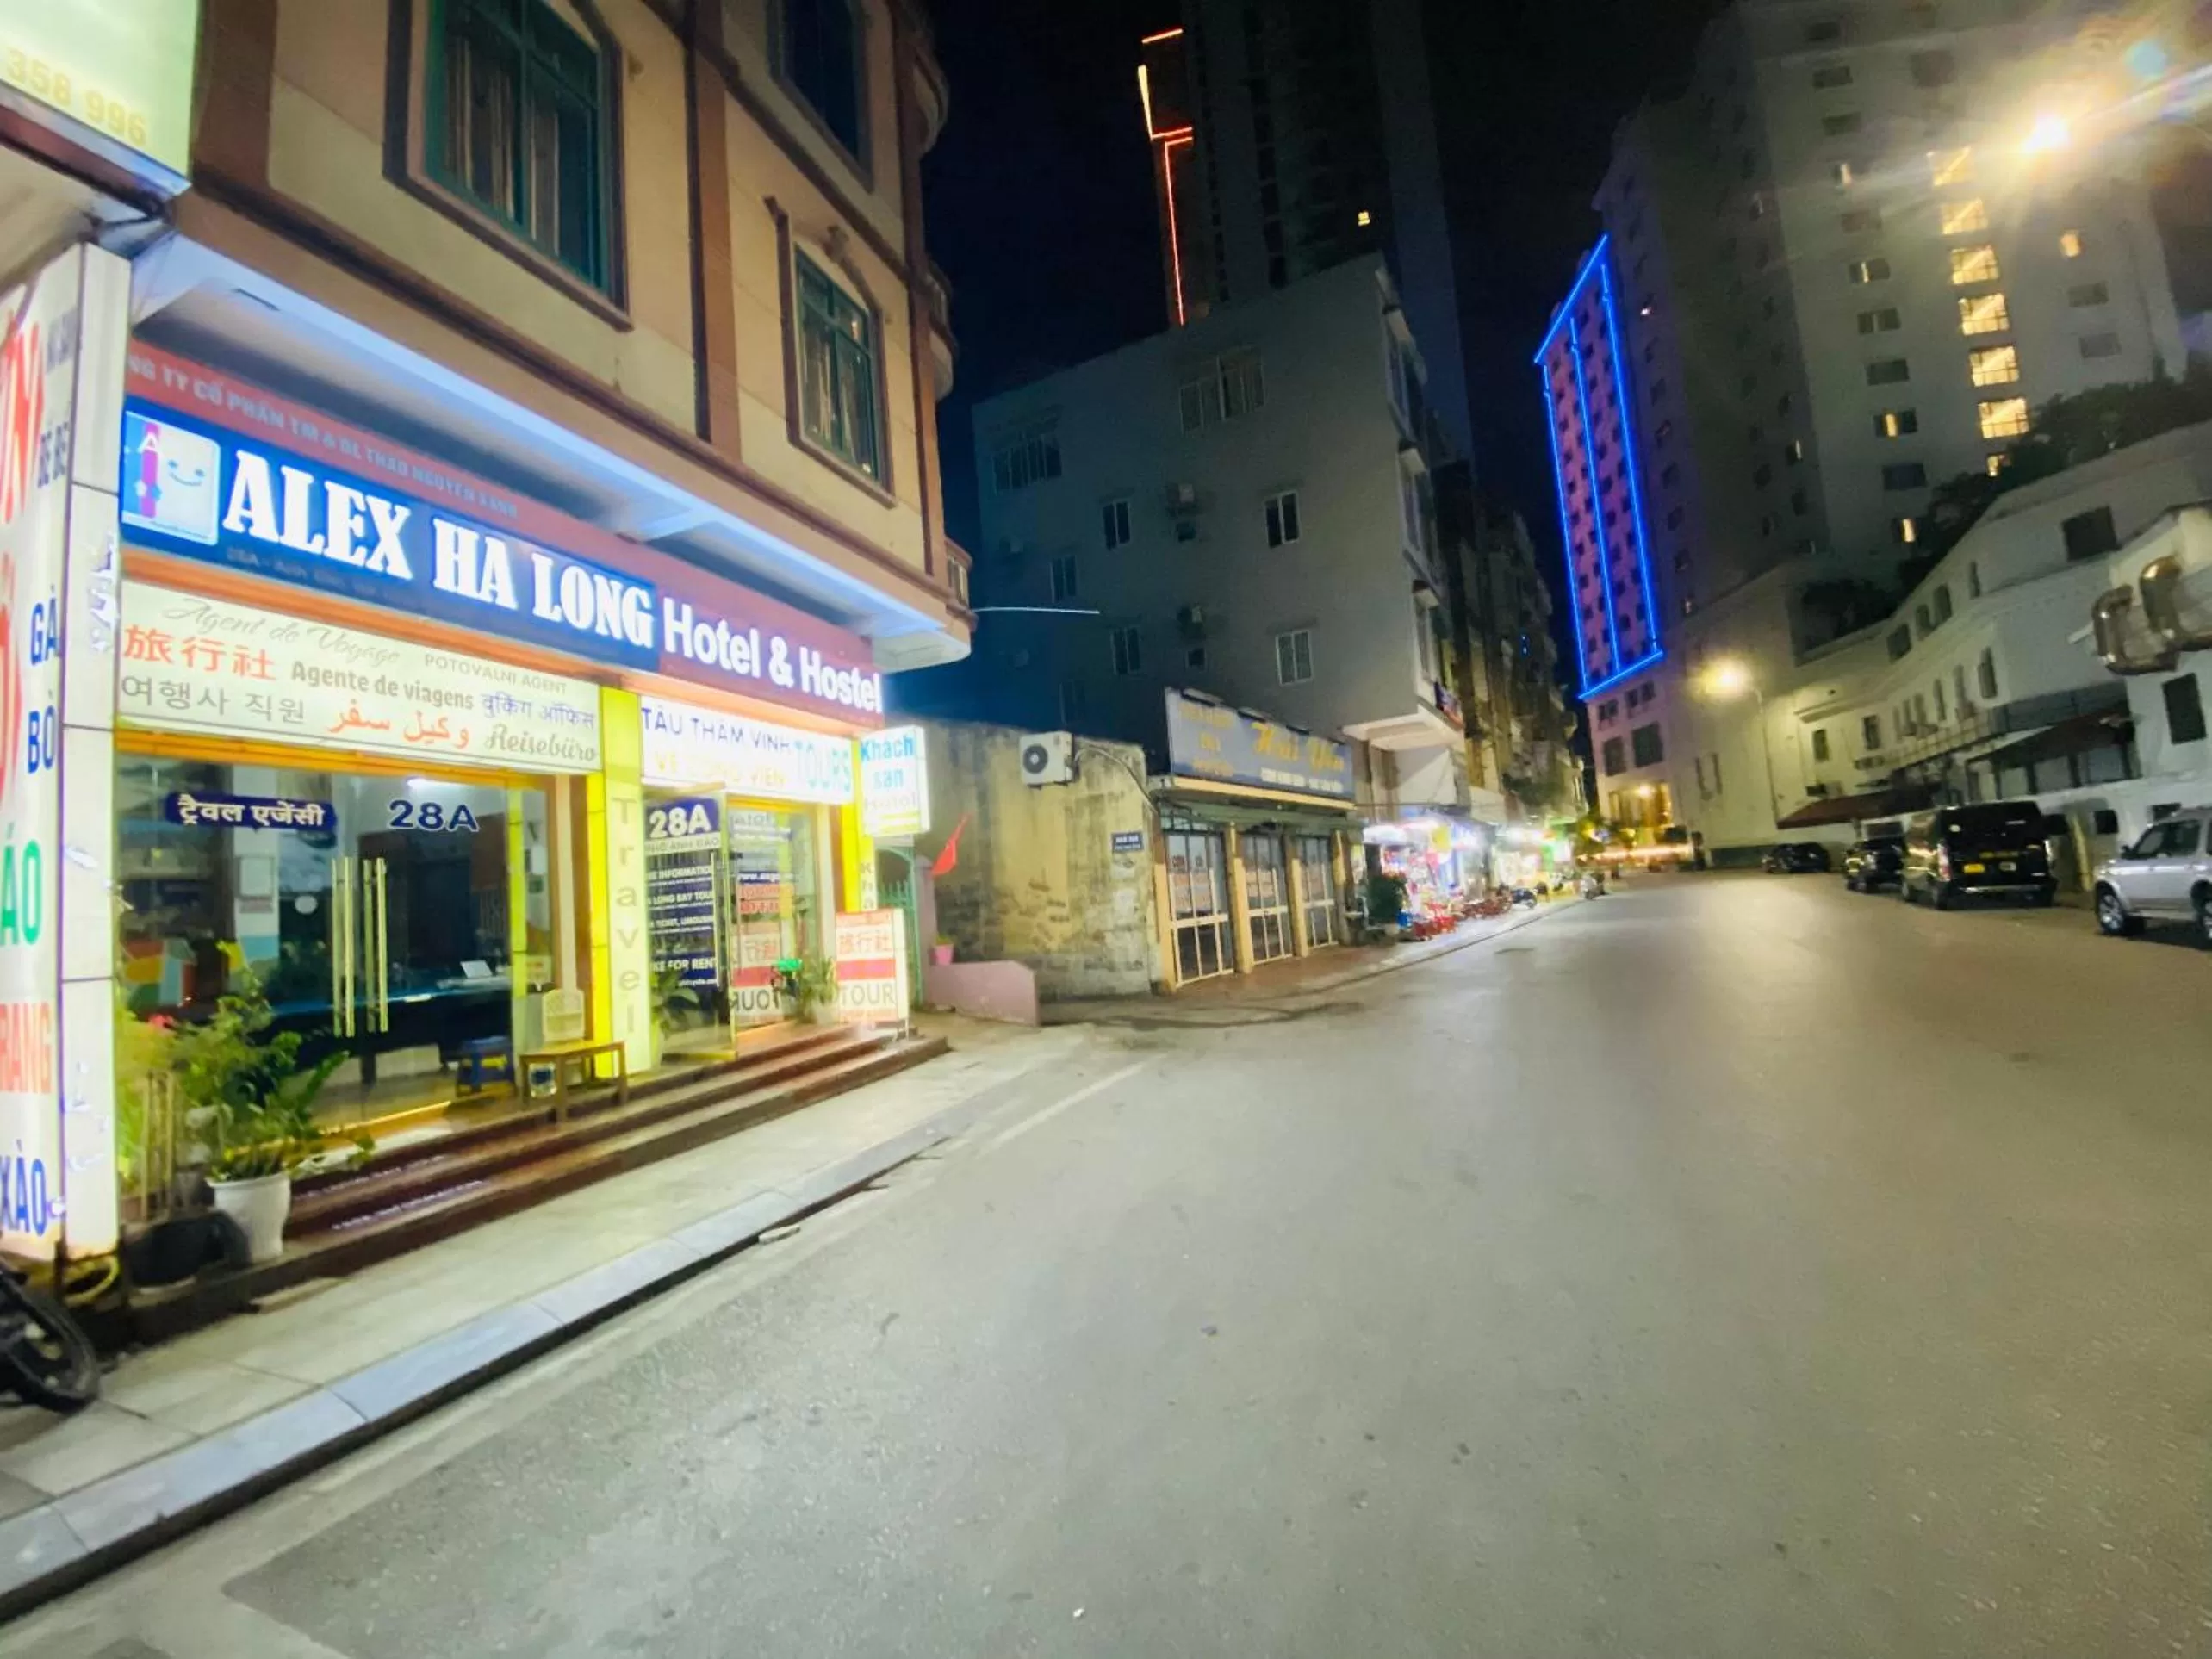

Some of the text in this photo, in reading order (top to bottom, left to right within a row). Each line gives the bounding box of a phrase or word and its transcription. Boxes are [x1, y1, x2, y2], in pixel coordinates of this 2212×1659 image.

[5, 47, 146, 147] 358 996
[223, 449, 655, 649] ALEX HA LONG
[123, 624, 276, 681] 旅行社
[165, 598, 401, 668] Agent de Voyage
[662, 597, 884, 713] Hotel & Hostel
[121, 674, 305, 725] 여행사 직원
[291, 660, 475, 710] Agente de viagens
[483, 723, 595, 762] Reisebüro
[252, 800, 326, 827] एजेंसी
[388, 799, 480, 832] 28A
[649, 803, 712, 839] 28A
[658, 865, 714, 879] INFORMATIO
[611, 797, 640, 1034] Travel
[694, 891, 714, 901] TOU
[668, 959, 690, 970] FOR
[838, 982, 897, 1007] TOUR
